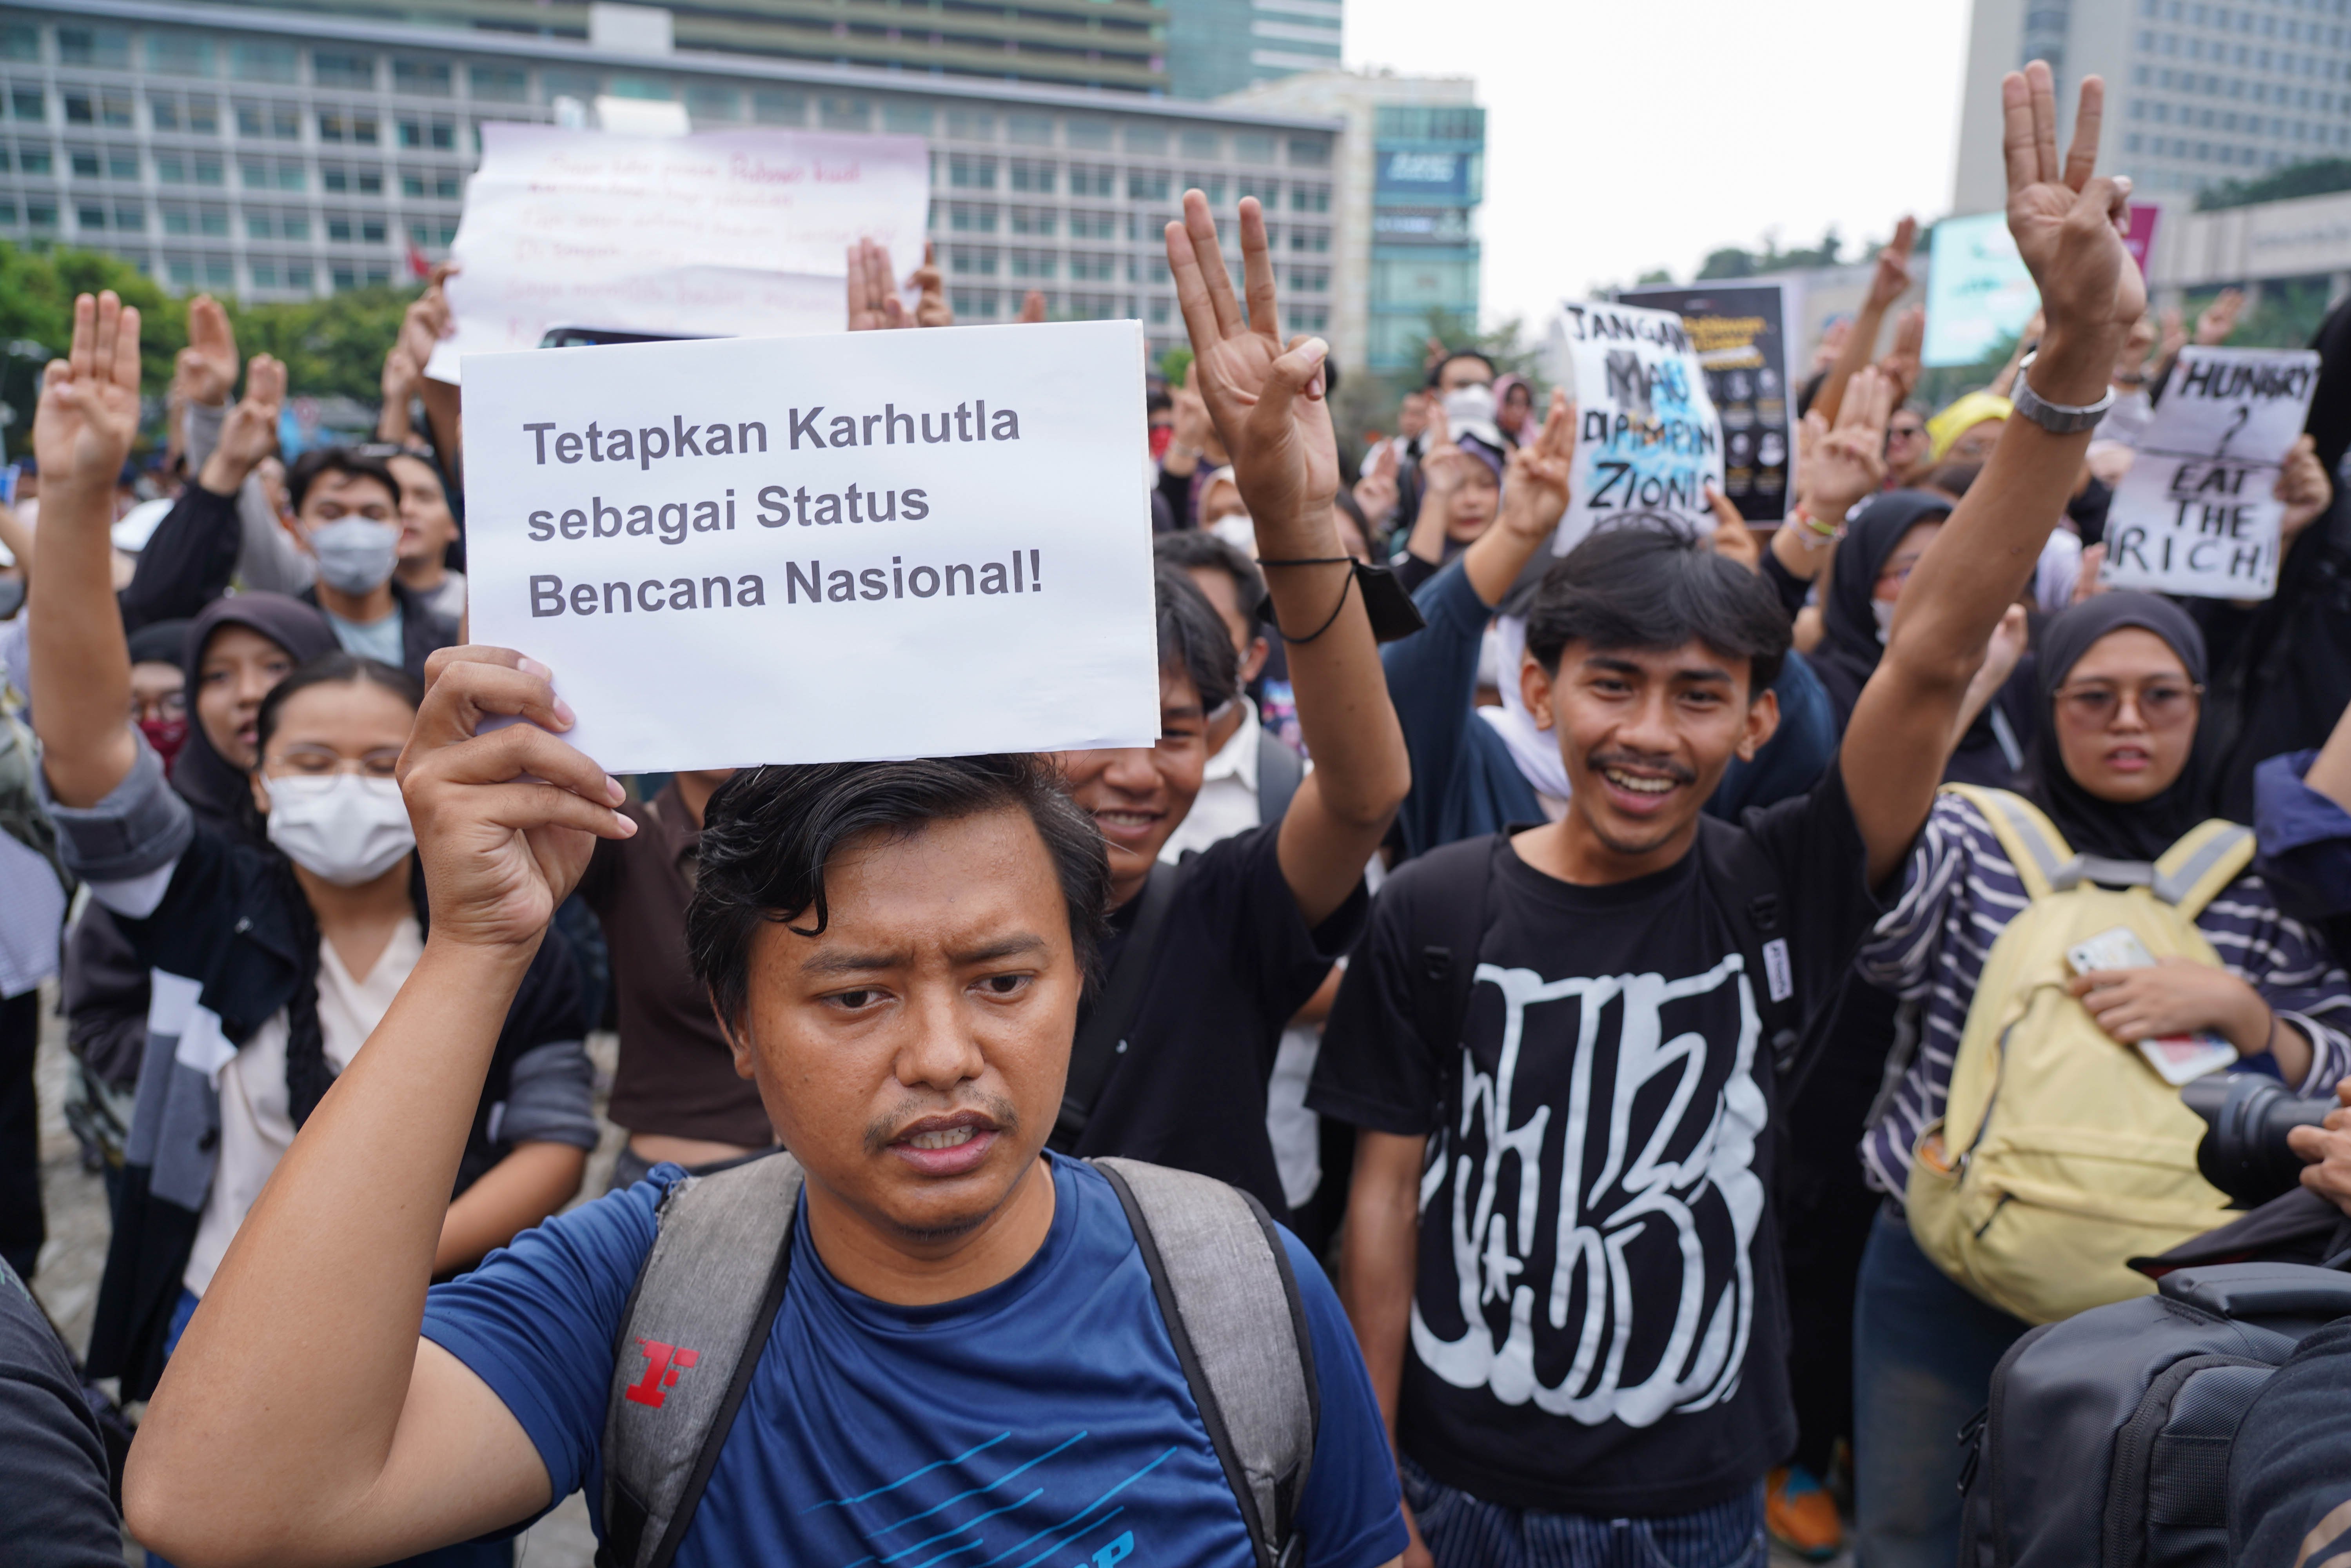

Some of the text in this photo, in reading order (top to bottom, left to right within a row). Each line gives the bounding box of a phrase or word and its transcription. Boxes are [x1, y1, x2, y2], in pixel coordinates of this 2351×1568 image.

[1567, 306, 1687, 353] JANGAN
[1606, 349, 1690, 408] MAU
[523, 399, 1020, 470] Tetapkan Karhutla
[2171, 463, 2255, 496] EAT
[528, 483, 929, 545] sebagai Status
[2175, 499, 2258, 539] THE
[530, 549, 1042, 618] Bencana Nasional!
